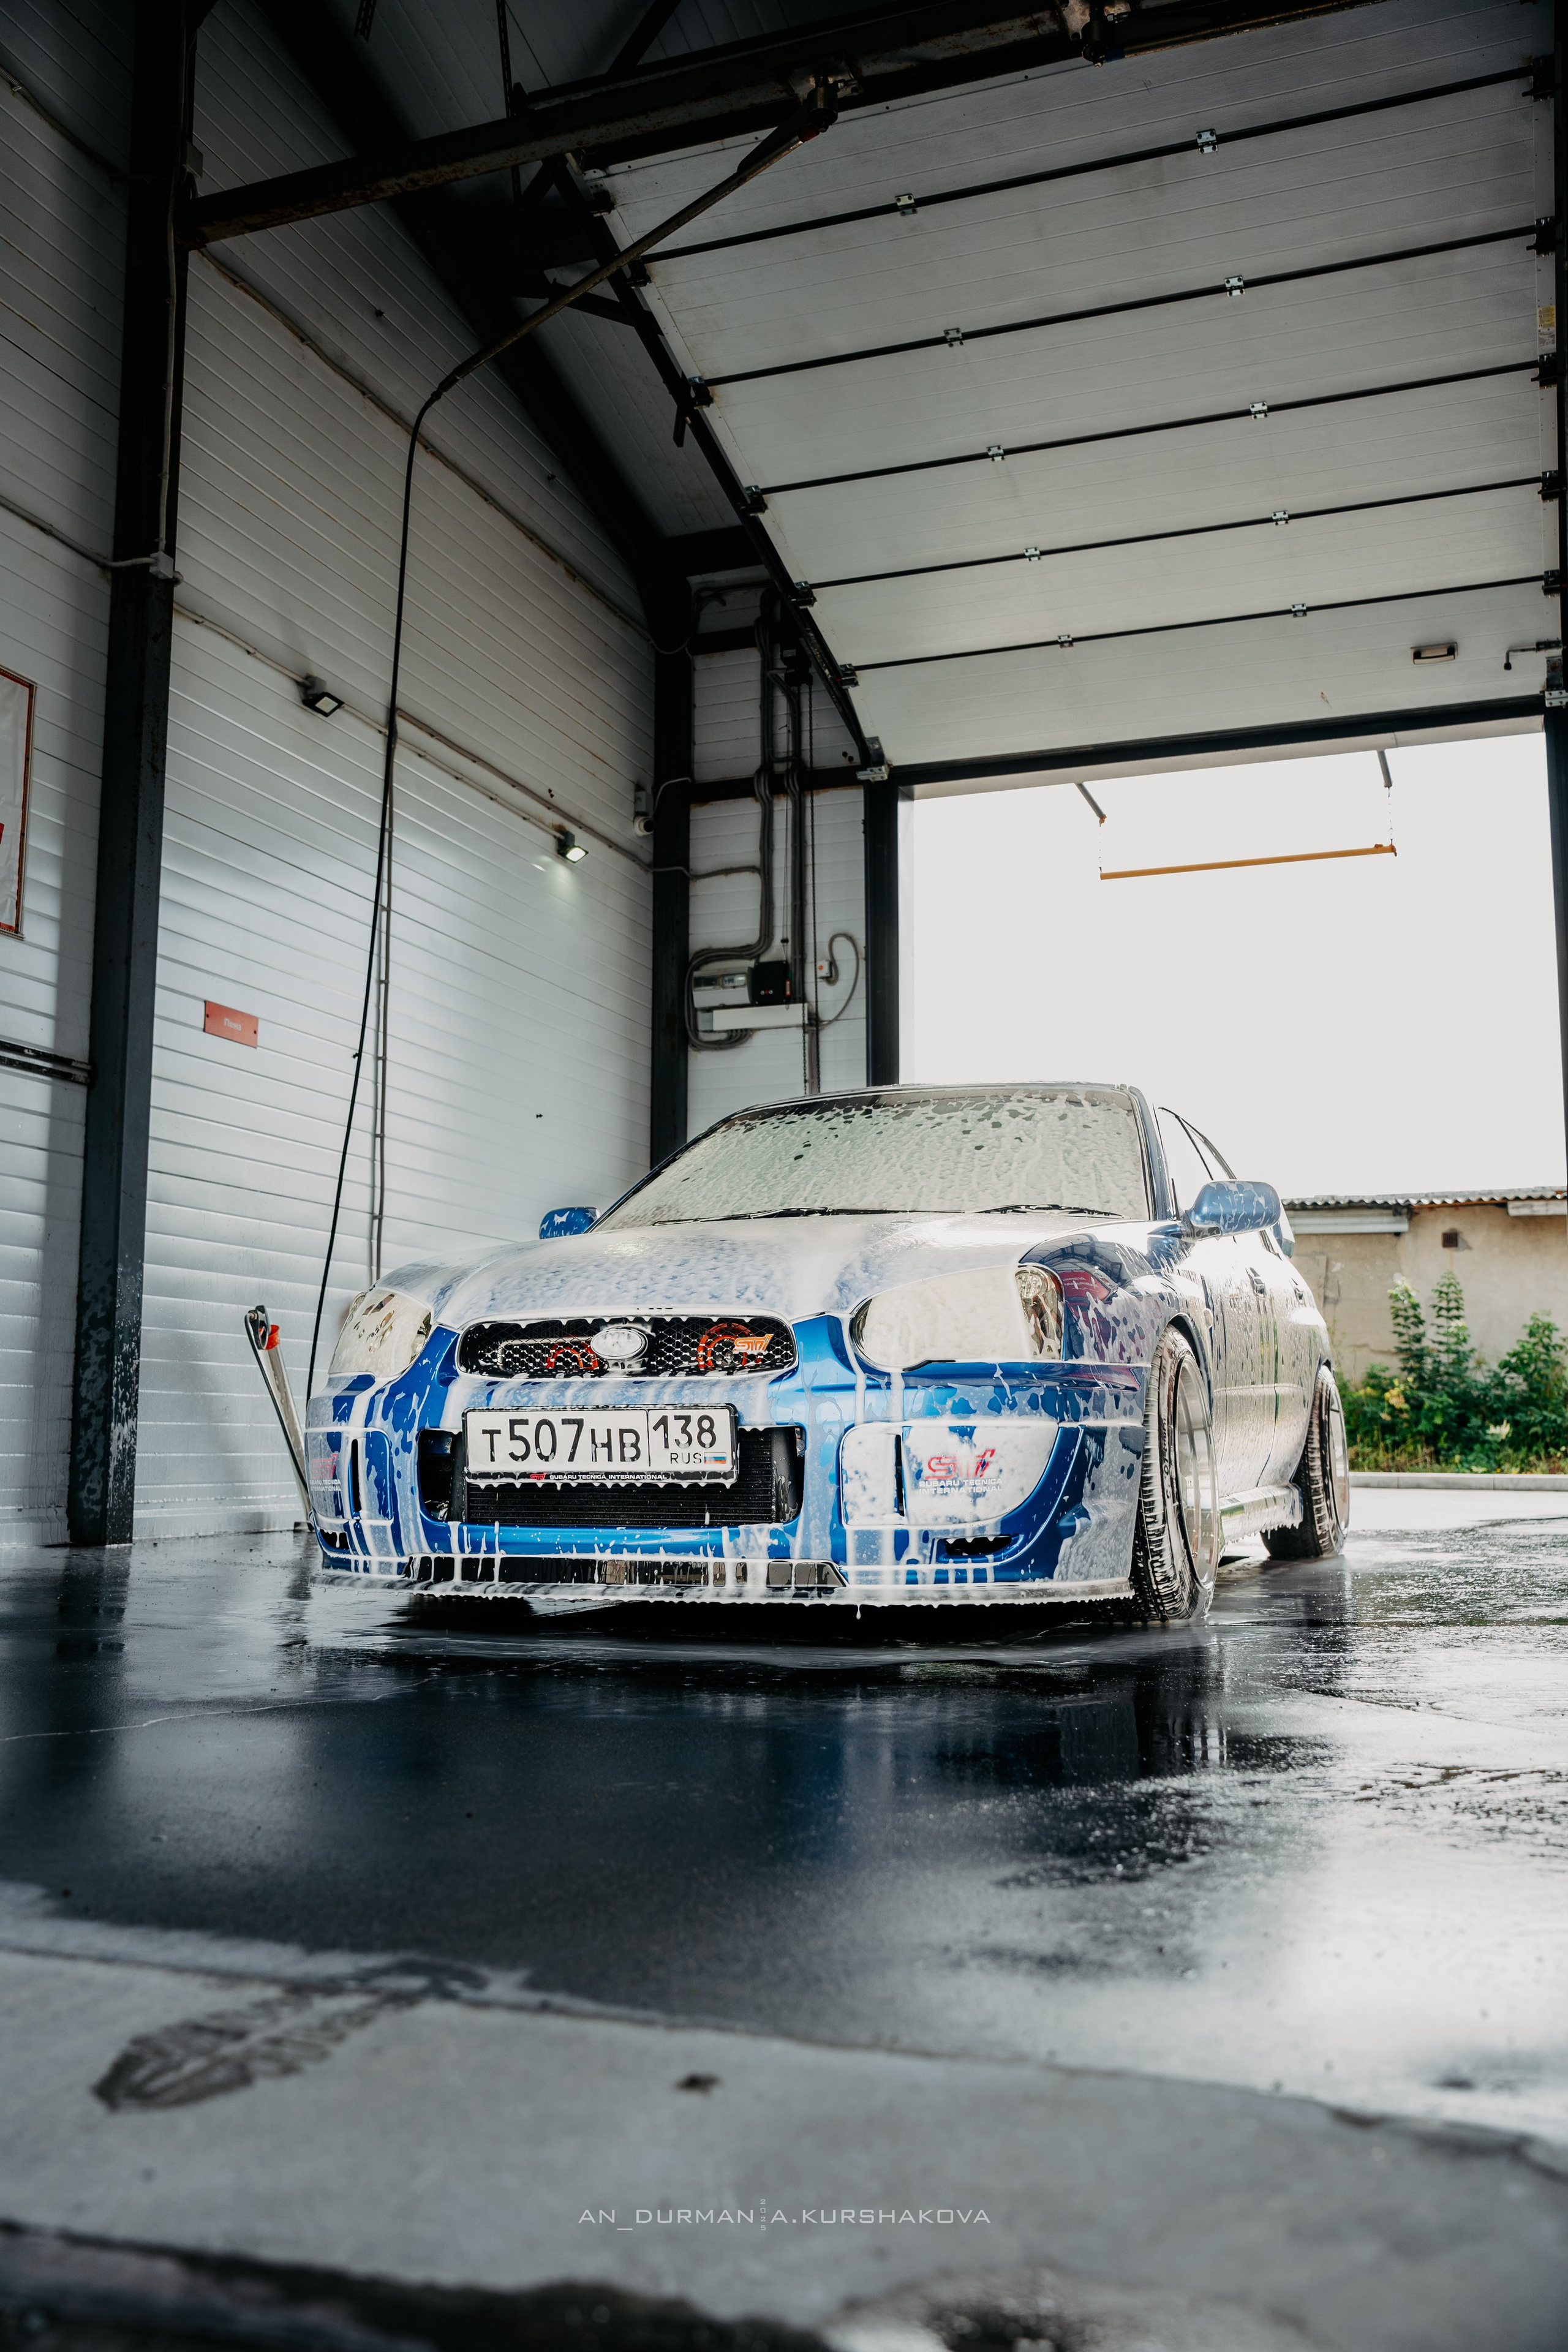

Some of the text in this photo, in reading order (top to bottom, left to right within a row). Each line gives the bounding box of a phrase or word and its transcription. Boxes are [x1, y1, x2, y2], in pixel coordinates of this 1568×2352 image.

[224, 1018, 242, 1031] Пена
[652, 1414, 717, 1449] 138
[669, 1452, 703, 1464] RUS
[919, 1485, 1003, 1494] INTERNATIONAL
